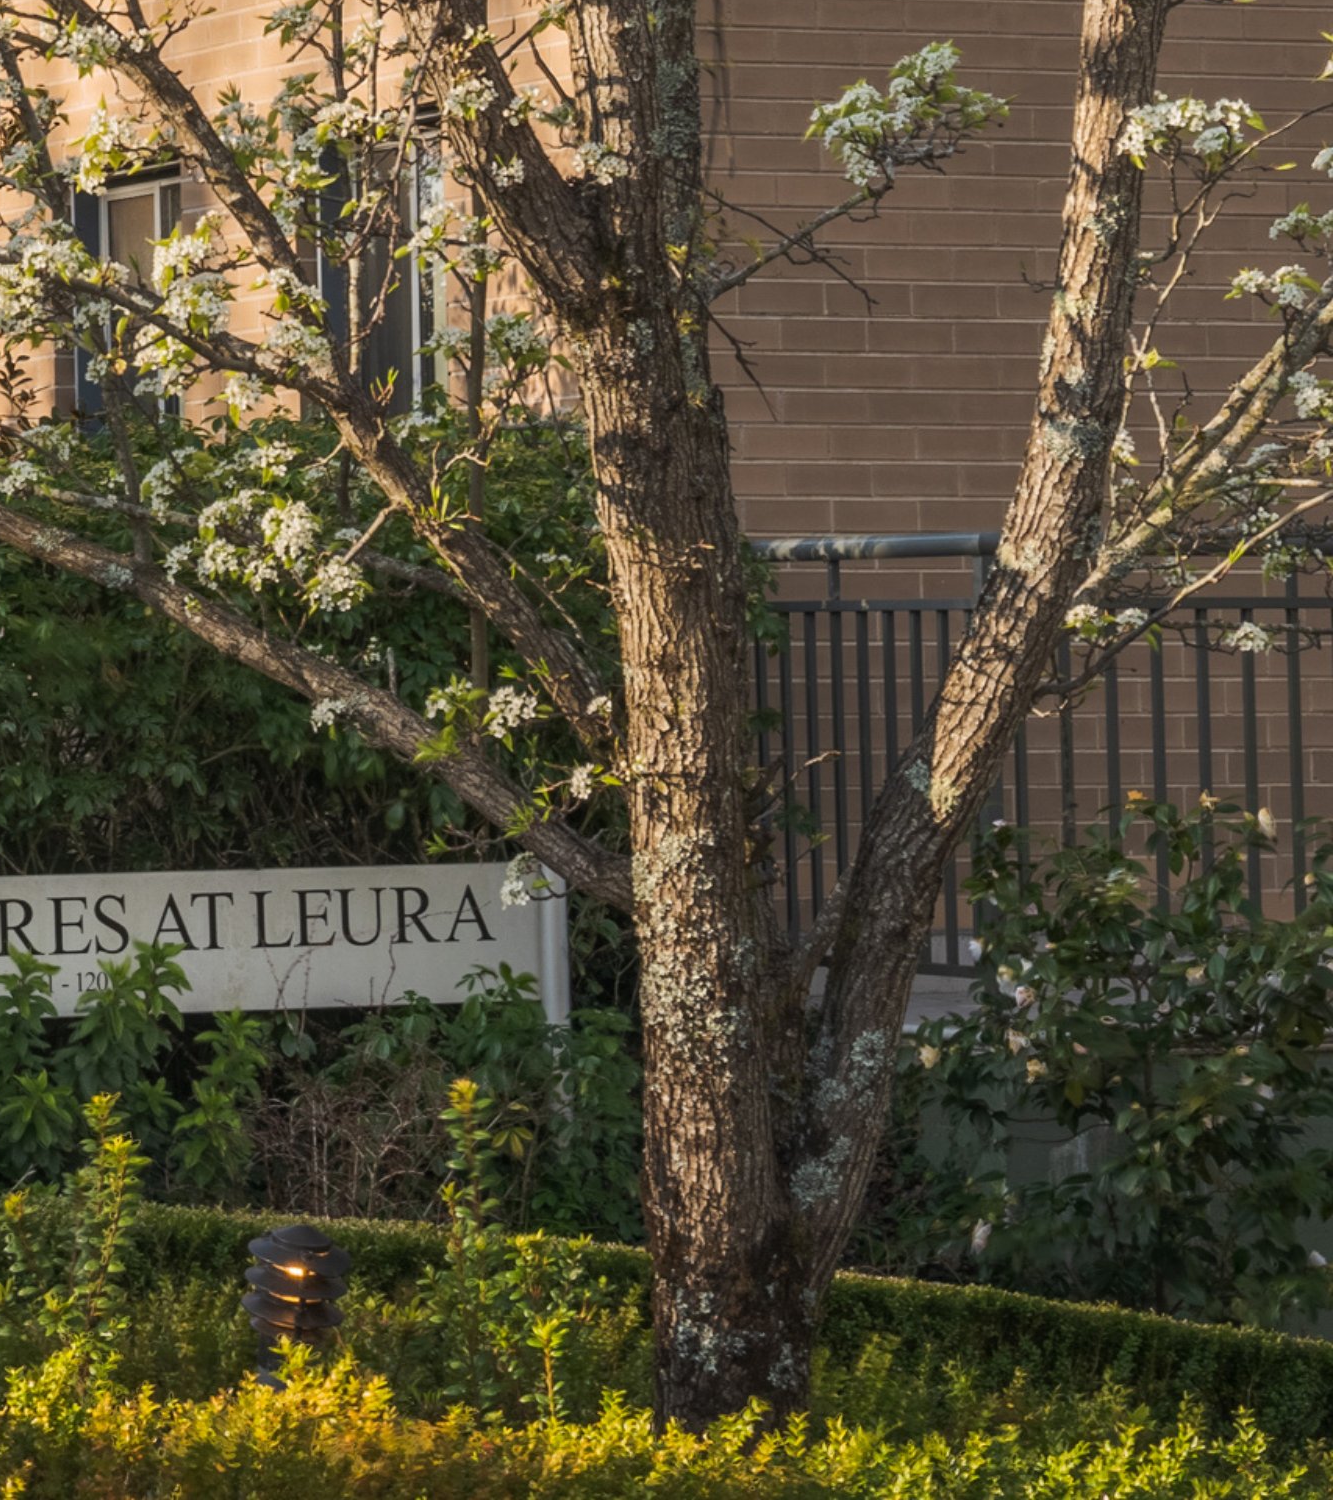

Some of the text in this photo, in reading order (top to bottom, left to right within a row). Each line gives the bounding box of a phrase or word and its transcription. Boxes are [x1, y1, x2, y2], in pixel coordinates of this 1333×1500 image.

[149, 891, 234, 952] AT
[249, 883, 497, 950] LEURA
[76, 971, 109, 993] 120
